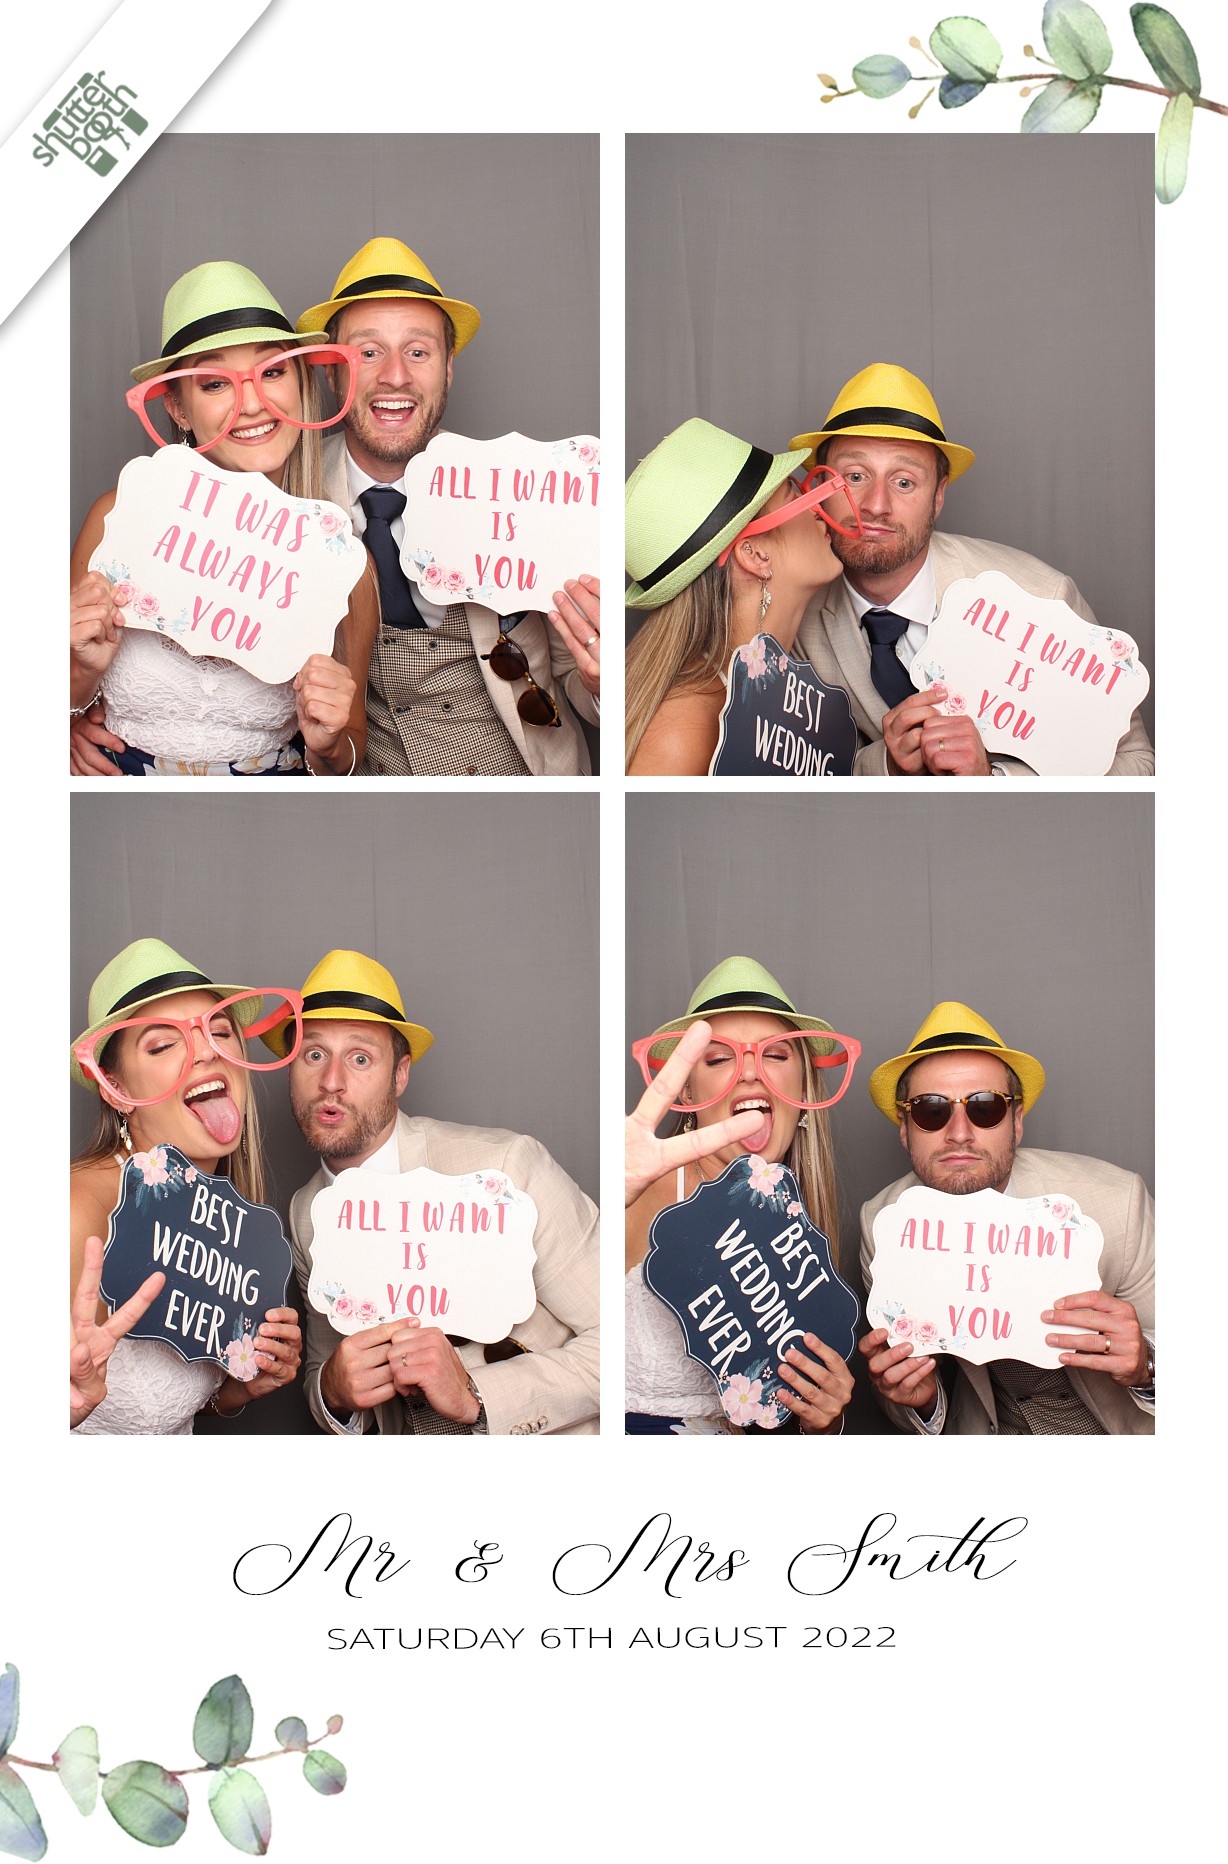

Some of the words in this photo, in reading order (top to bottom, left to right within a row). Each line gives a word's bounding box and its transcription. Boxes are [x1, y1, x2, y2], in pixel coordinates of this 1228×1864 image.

[179, 470, 227, 516] IT
[235, 492, 310, 553] WAS
[429, 465, 477, 500] ALL
[489, 468, 501, 502] I
[513, 469, 600, 507] WANT
[491, 511, 517, 542] IS
[153, 525, 300, 609] ALWAYS
[475, 553, 539, 591] YOU
[190, 596, 262, 651] YOU
[963, 597, 1007, 642] ALL
[1017, 621, 1039, 654] I
[1040, 632, 1127, 696] WANT
[1005, 659, 1034, 690] IS
[783, 671, 826, 734] BEST
[977, 689, 1038, 741] YOU
[191, 1184, 248, 1249] BEST
[338, 1199, 387, 1233] ALL
[399, 1201, 411, 1233] I
[422, 1202, 511, 1235] WANT
[900, 1218, 951, 1251] ALL
[963, 1221, 976, 1254] I
[987, 1223, 1077, 1259] WANT
[153, 1220, 260, 1306] WEDDING
[402, 1241, 429, 1271] IS
[770, 1221, 830, 1302] BEST
[965, 1263, 993, 1293] IS
[386, 1283, 451, 1318] YOU
[714, 1218, 806, 1364] WEDDING
[166, 1288, 227, 1355] EVER
[688, 1284, 753, 1372] EVER
[948, 1304, 1013, 1341] YOU
